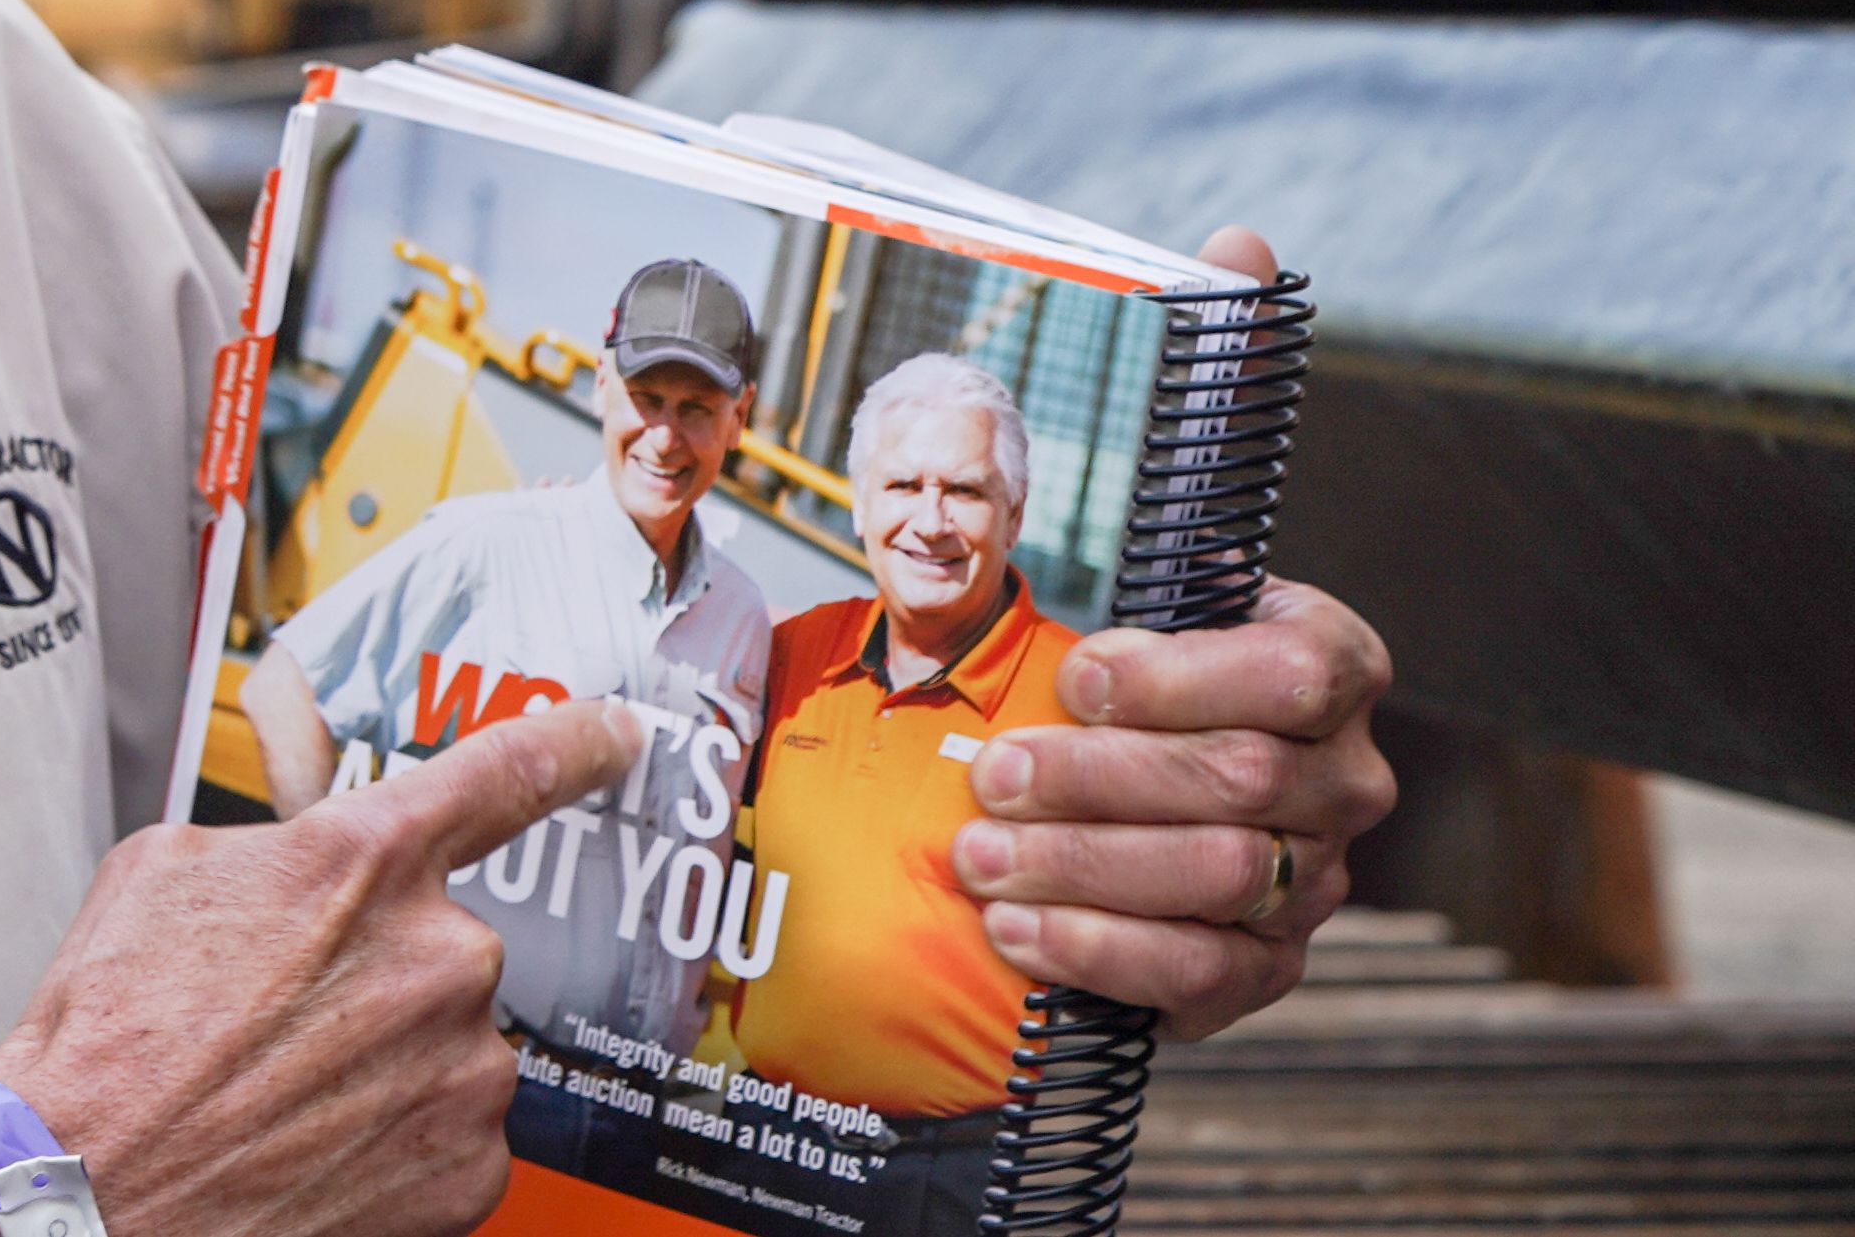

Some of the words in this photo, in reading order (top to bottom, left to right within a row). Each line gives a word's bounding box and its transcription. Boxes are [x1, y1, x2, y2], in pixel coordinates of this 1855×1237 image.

[585, 694, 742, 840] T'S
[616, 822, 790, 980] YOU
[515, 1044, 564, 1088] lute
[565, 1068, 655, 1117] auction
[662, 1097, 732, 1145] mean
[738, 1123, 754, 1150] a
[759, 1126, 795, 1163] lot
[798, 1139, 826, 1172] to
[677, 1058, 725, 1092] and
[728, 1073, 793, 1112] good
[794, 1092, 883, 1137] people
[751, 1186, 814, 1219] Newman
[814, 1204, 865, 1233] Tractor
